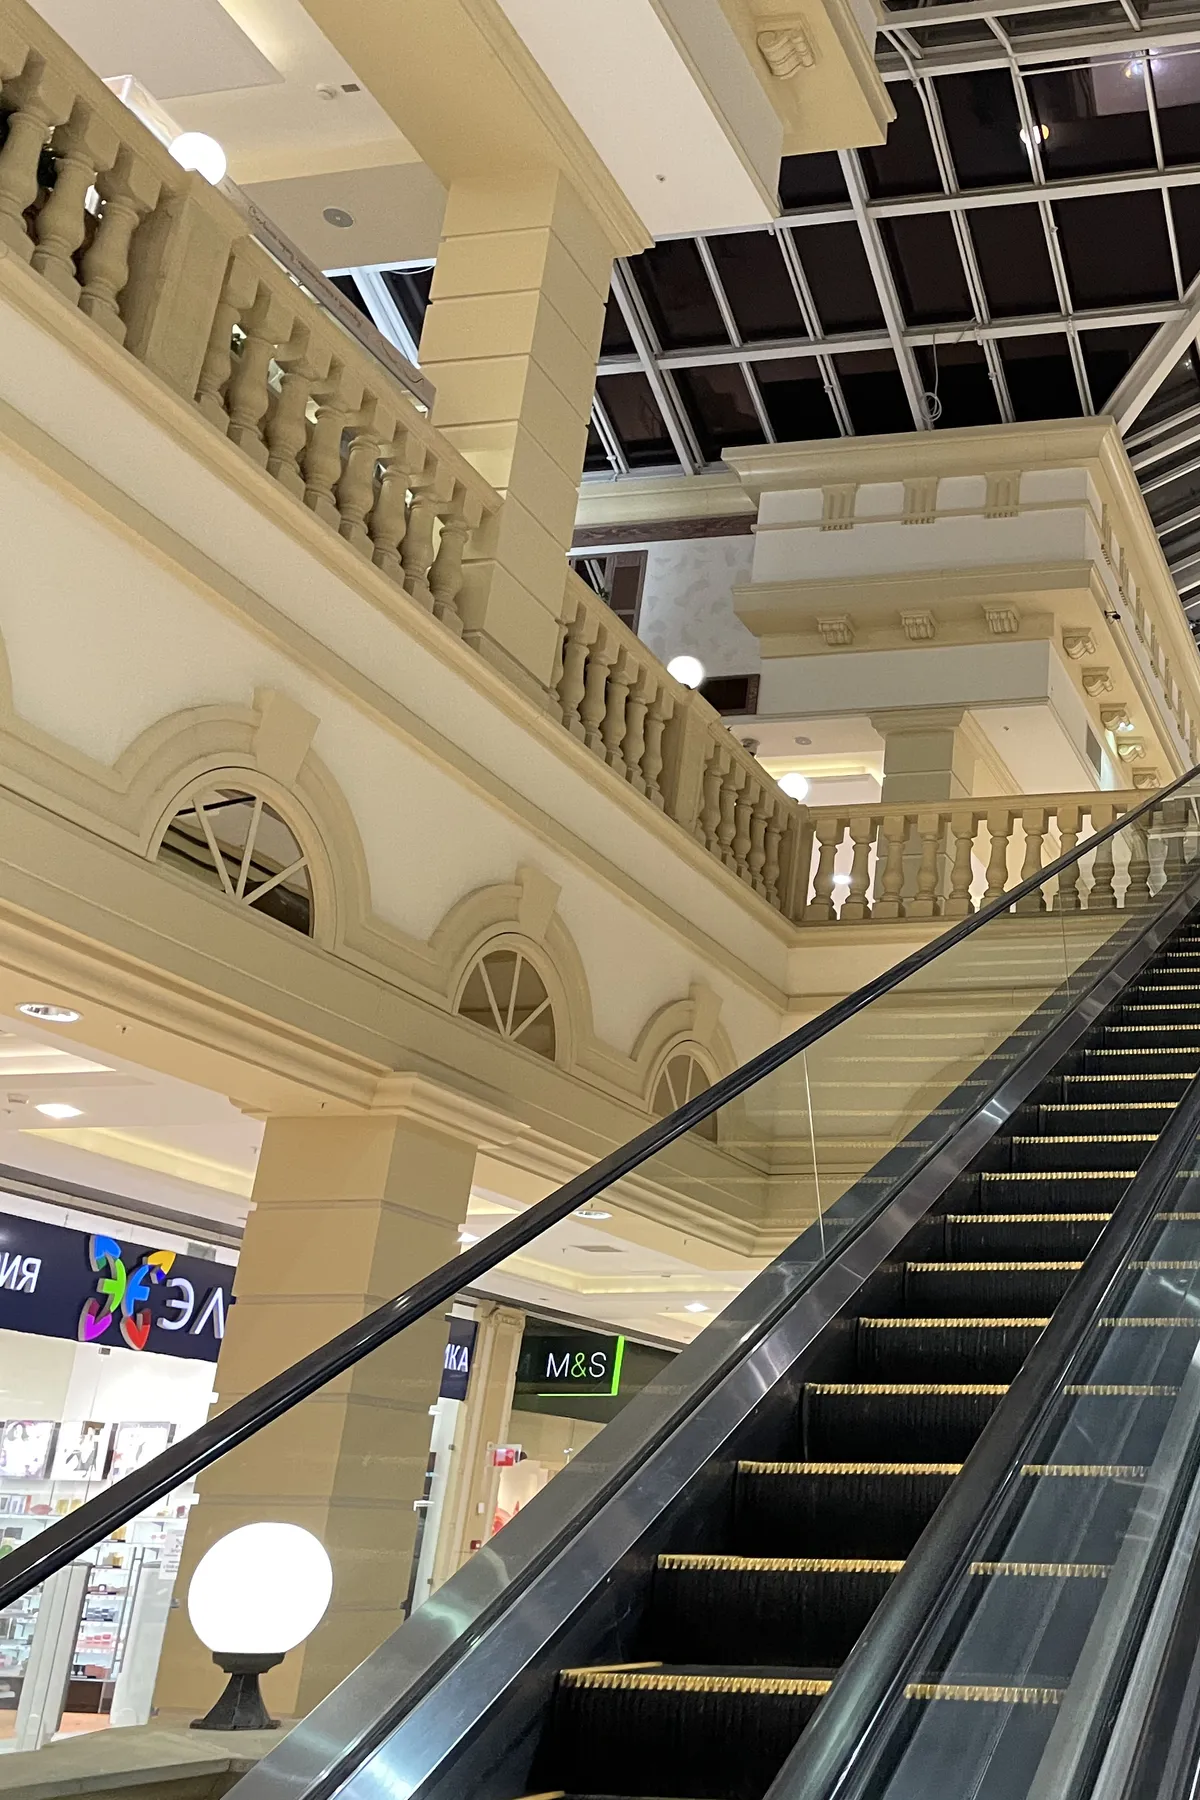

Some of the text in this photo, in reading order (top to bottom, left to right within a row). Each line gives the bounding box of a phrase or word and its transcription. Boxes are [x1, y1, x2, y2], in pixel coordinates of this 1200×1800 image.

[0, 1252, 42, 1293] ИЯ
[158, 1277, 225, 1339] ЭЛ
[545, 1351, 607, 1378] M&S
